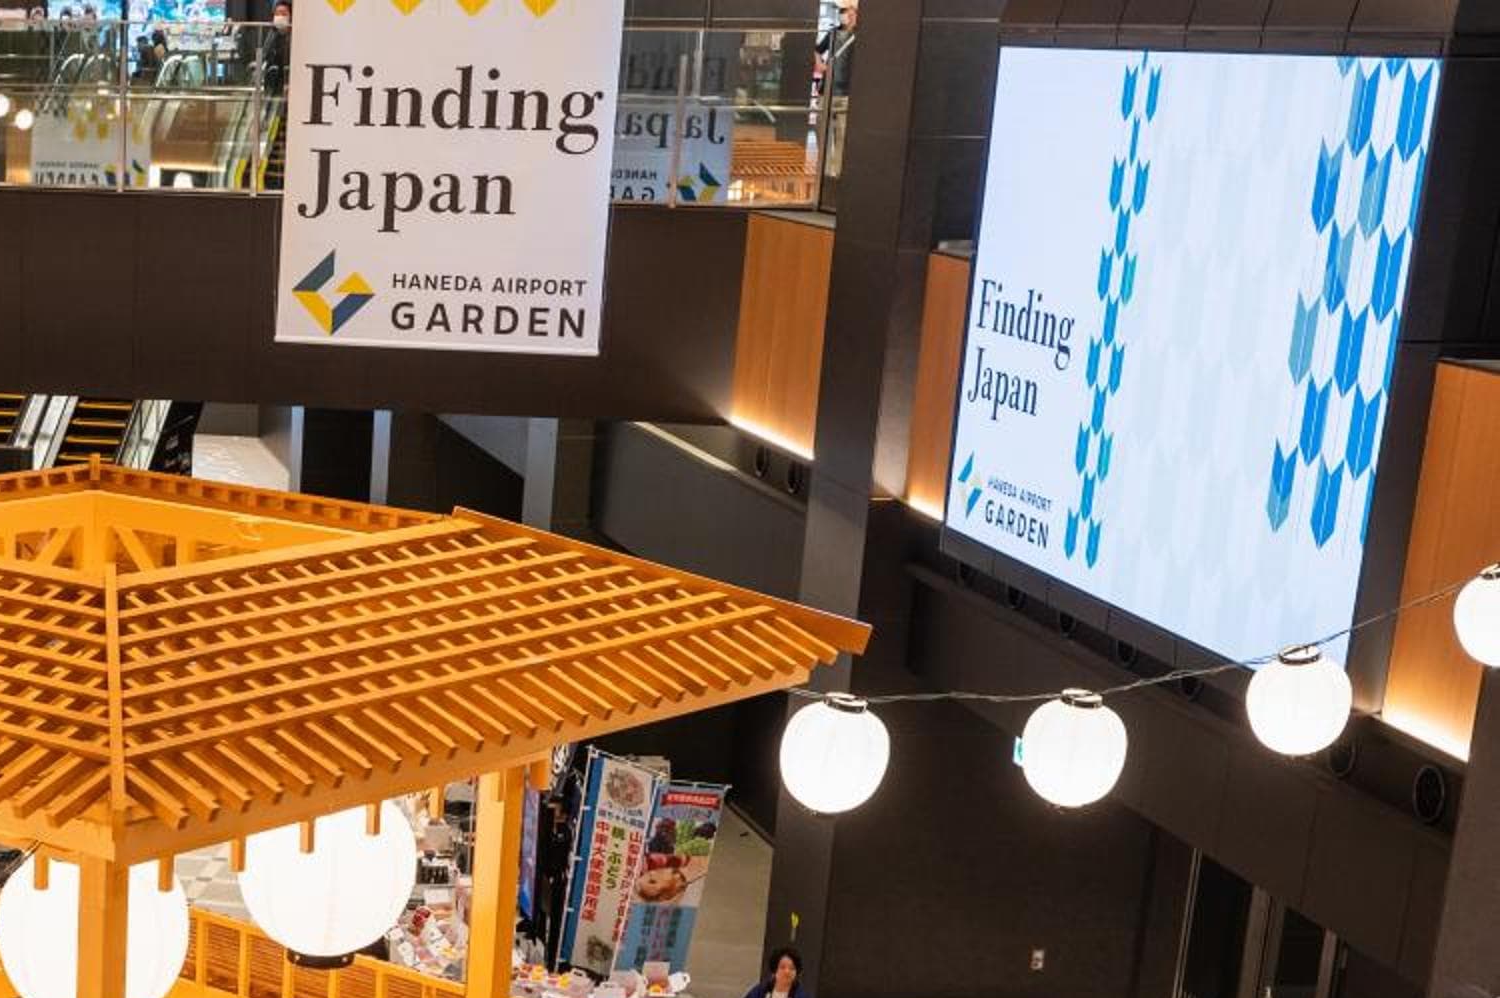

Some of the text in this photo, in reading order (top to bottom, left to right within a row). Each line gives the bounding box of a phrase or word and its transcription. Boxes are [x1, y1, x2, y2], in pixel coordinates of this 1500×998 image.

[301, 62, 604, 155] Finding
[297, 148, 516, 233] Japan
[391, 301, 586, 338] GARDEN
[392, 273, 587, 297] HANEDA AIRPORT
[976, 277, 1075, 371] Finding
[968, 346, 1038, 421] Japan
[985, 499, 1049, 549] GARDEN
